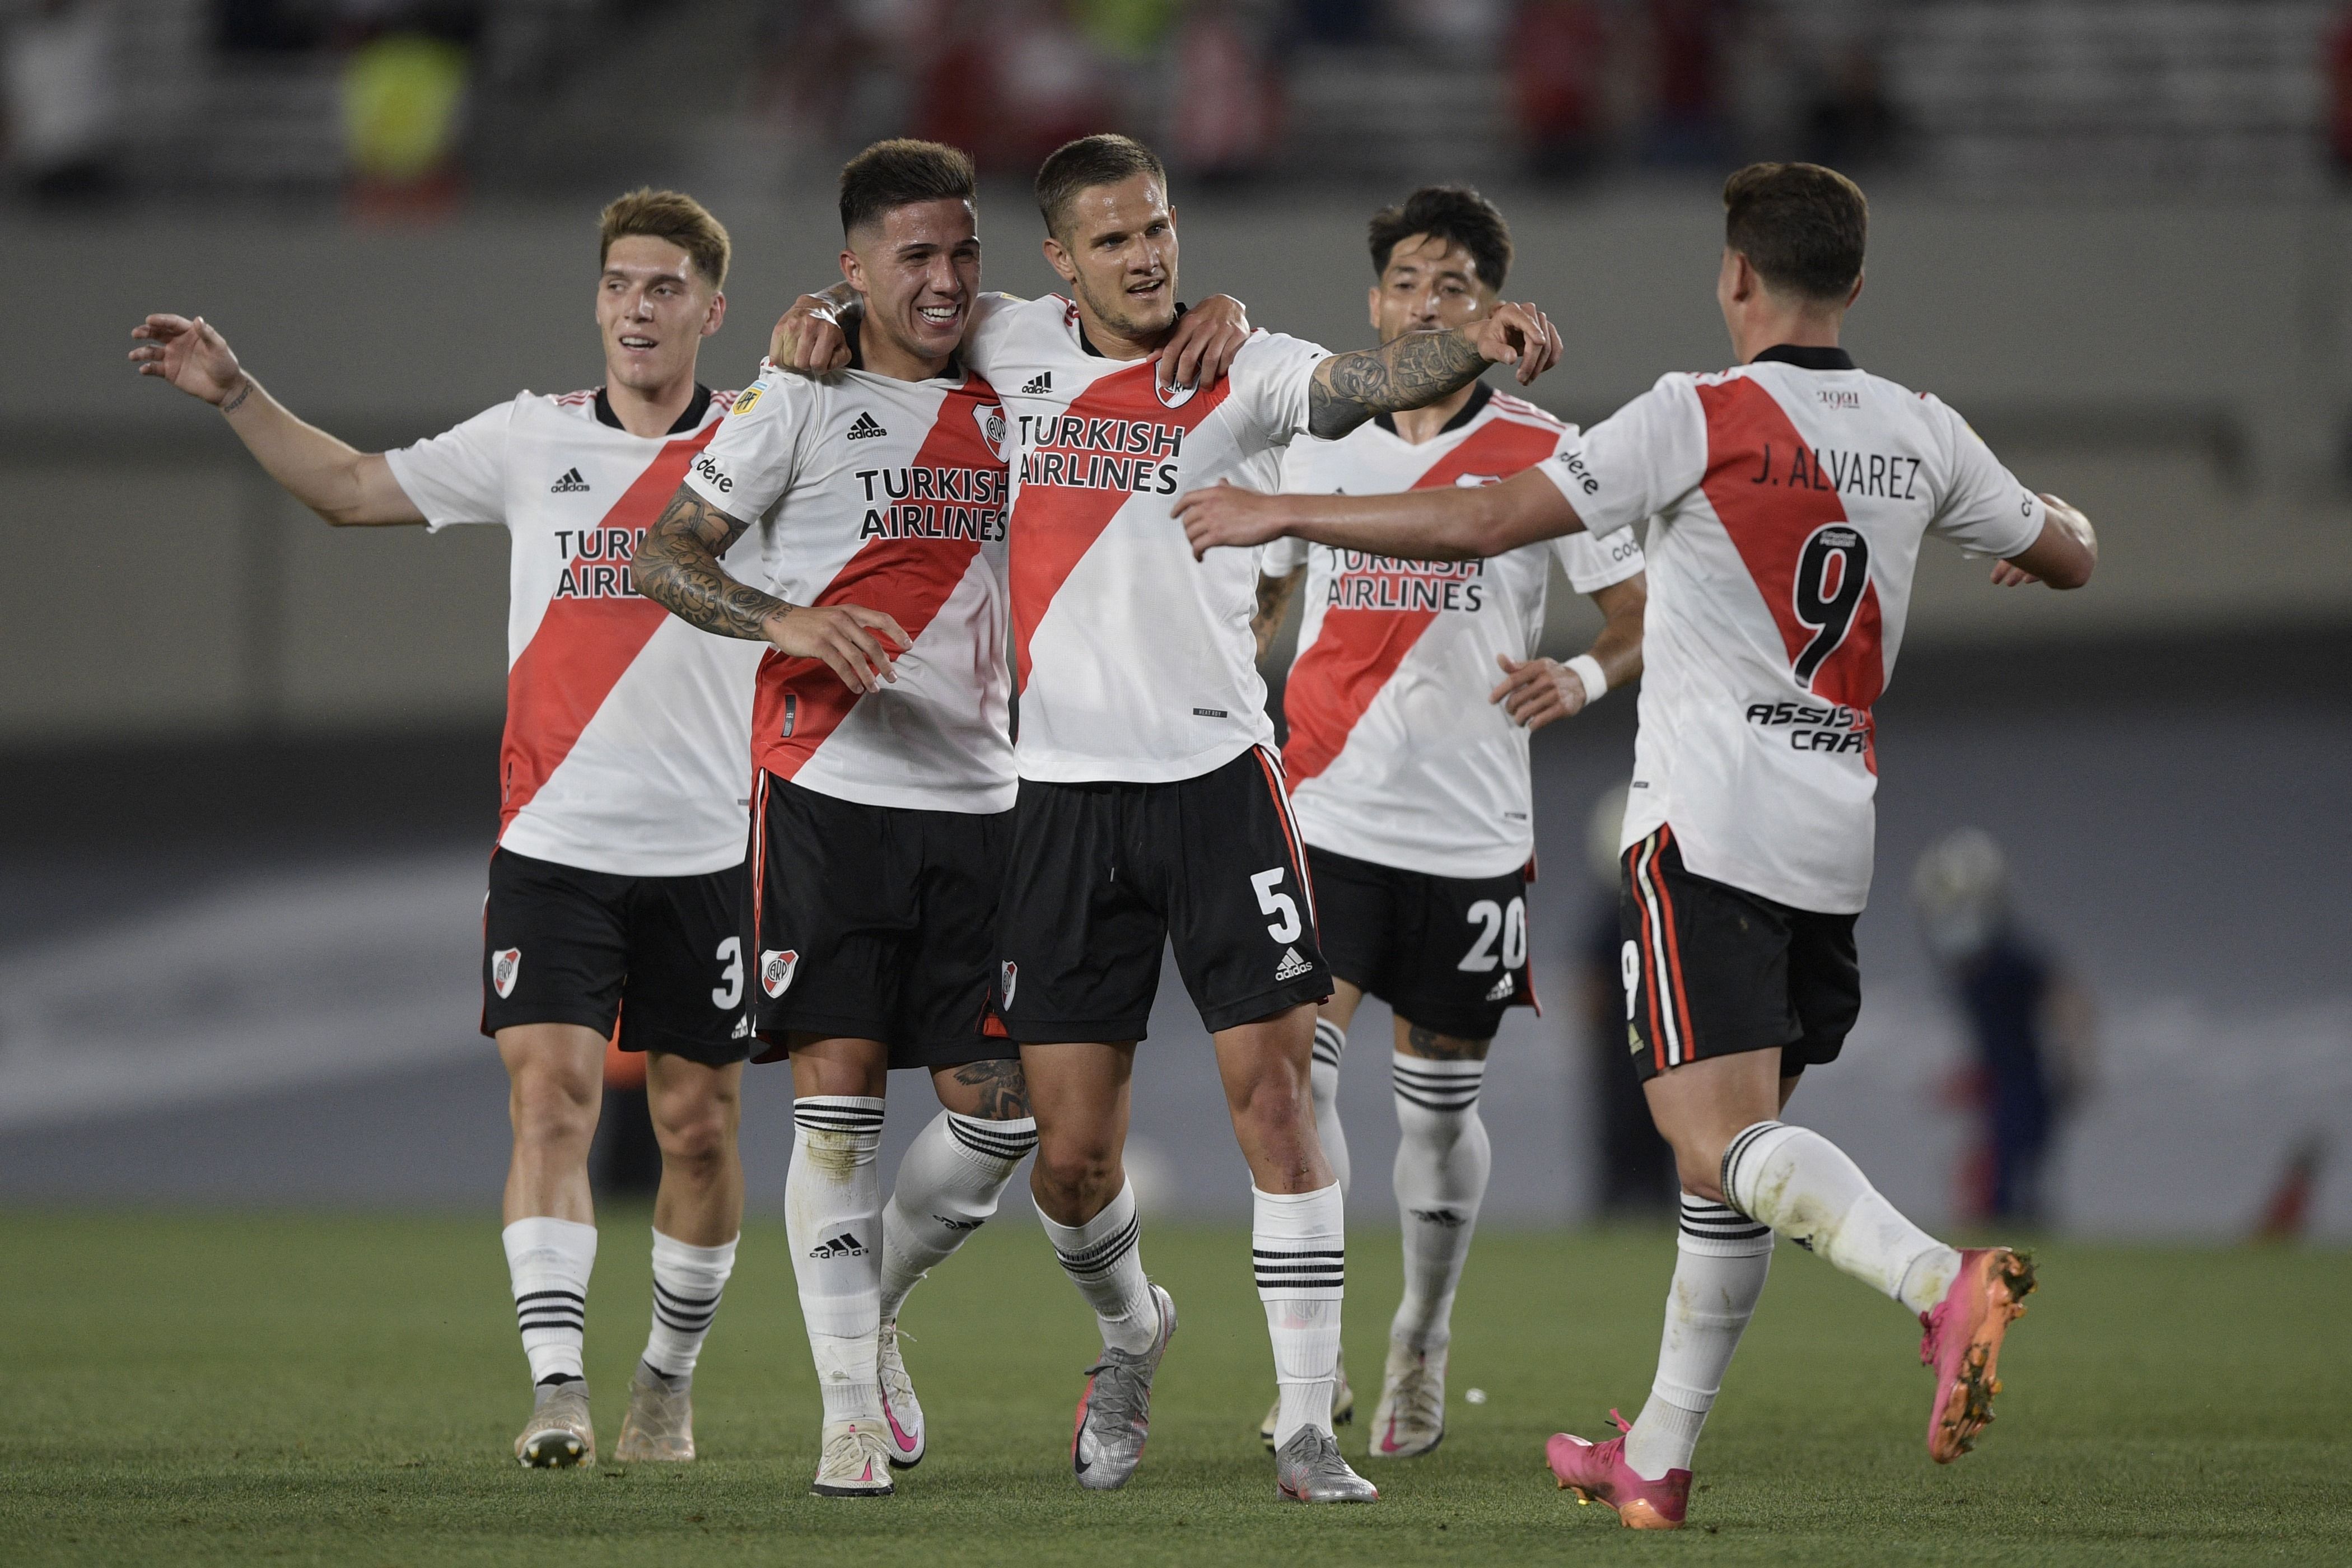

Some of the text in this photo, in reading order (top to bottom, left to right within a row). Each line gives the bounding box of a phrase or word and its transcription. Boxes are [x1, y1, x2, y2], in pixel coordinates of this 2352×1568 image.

[847, 427, 888, 441] adidas
[1018, 416, 1183, 458] TURKISH
[550, 482, 590, 493] adidas
[696, 457, 733, 493] dere
[855, 468, 1009, 504] TURKISH
[1018, 452, 1178, 495] AIRLINES
[1560, 451, 1598, 495] dere
[1751, 442, 1921, 500] J. ALVAREZ
[860, 506, 1007, 542] AIRLINES
[1327, 578, 1483, 613] AIRLINES
[1795, 523, 1870, 690] 9
[1250, 866, 1302, 944] 5
[1457, 896, 1527, 972] 20
[712, 936, 744, 1010] 3
[1275, 961, 1313, 981] adidas
[1621, 940, 1640, 1021] 9
